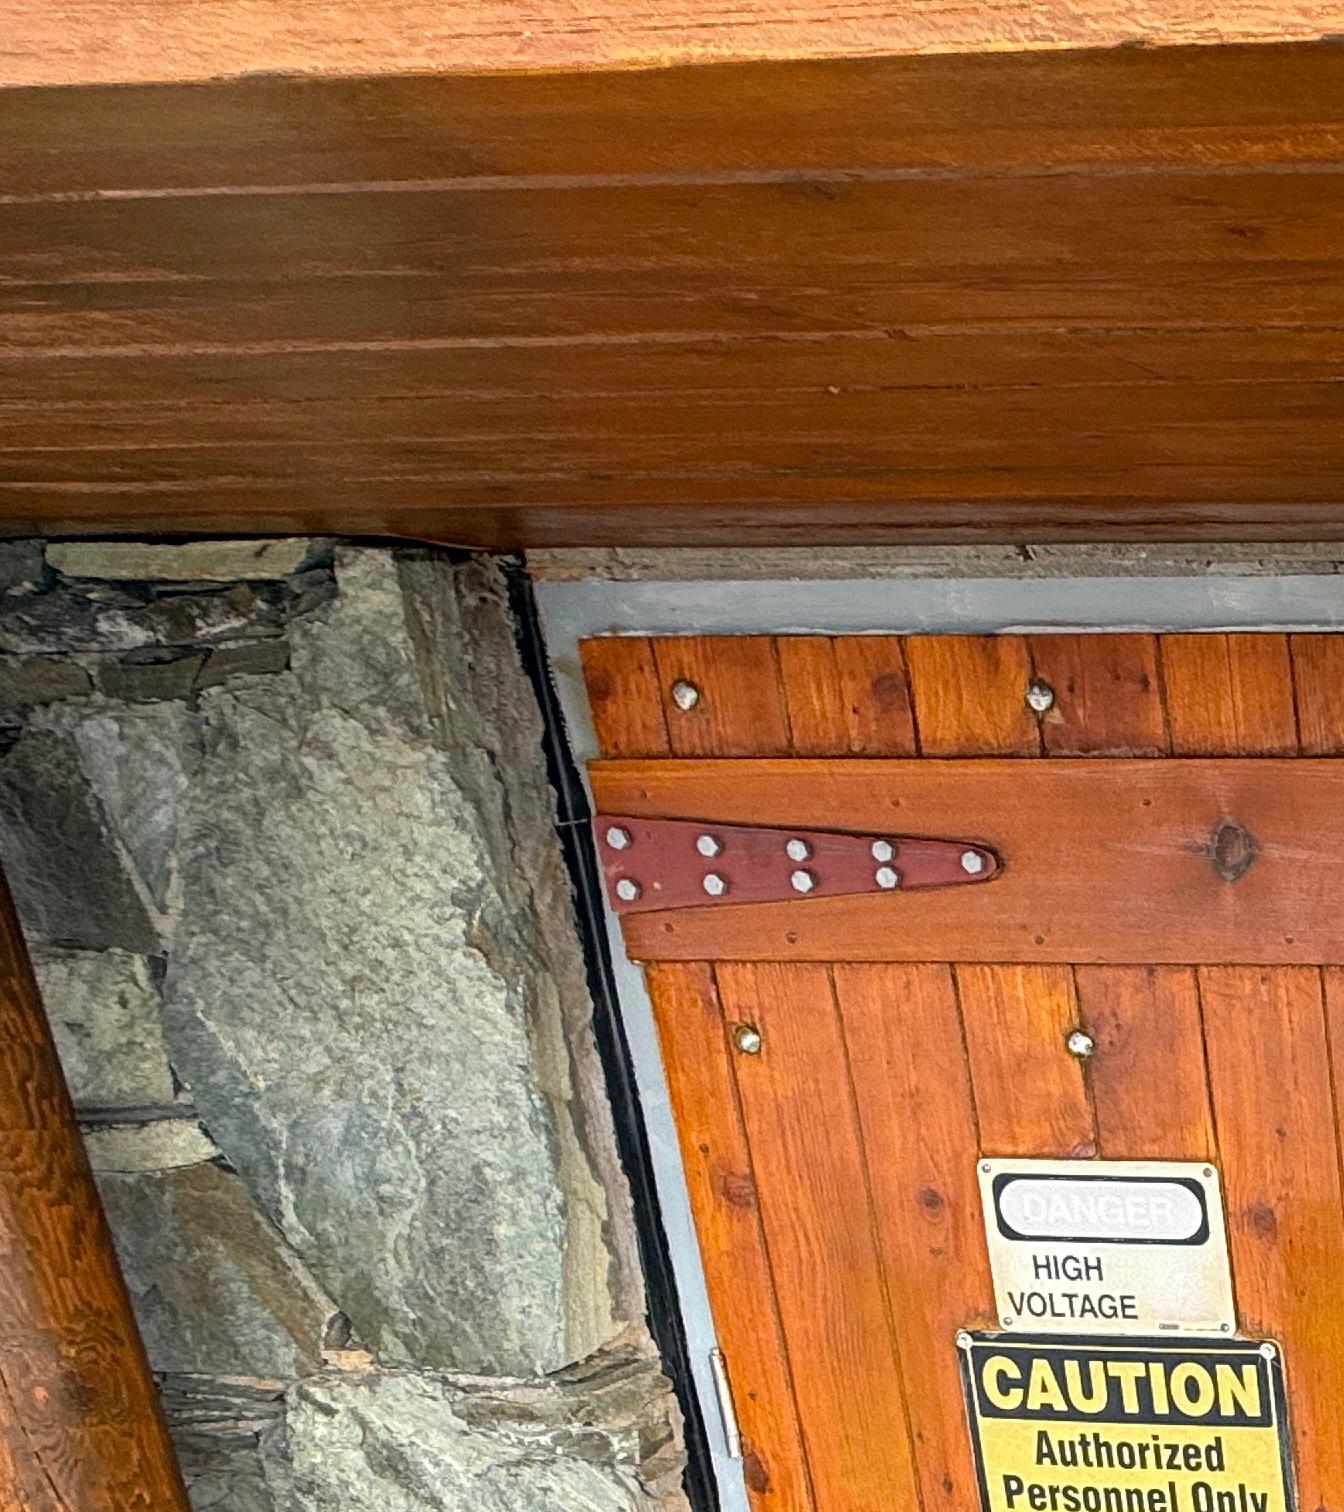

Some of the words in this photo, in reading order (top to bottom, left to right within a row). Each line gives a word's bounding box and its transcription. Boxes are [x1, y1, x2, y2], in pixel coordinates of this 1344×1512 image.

[1021, 1192, 1176, 1227] DANGER
[1032, 1254, 1104, 1282] HIGH
[1007, 1291, 1139, 1320] VOLTAGE
[981, 1355, 1262, 1418] CAUTION
[1035, 1429, 1226, 1472] Authorized
